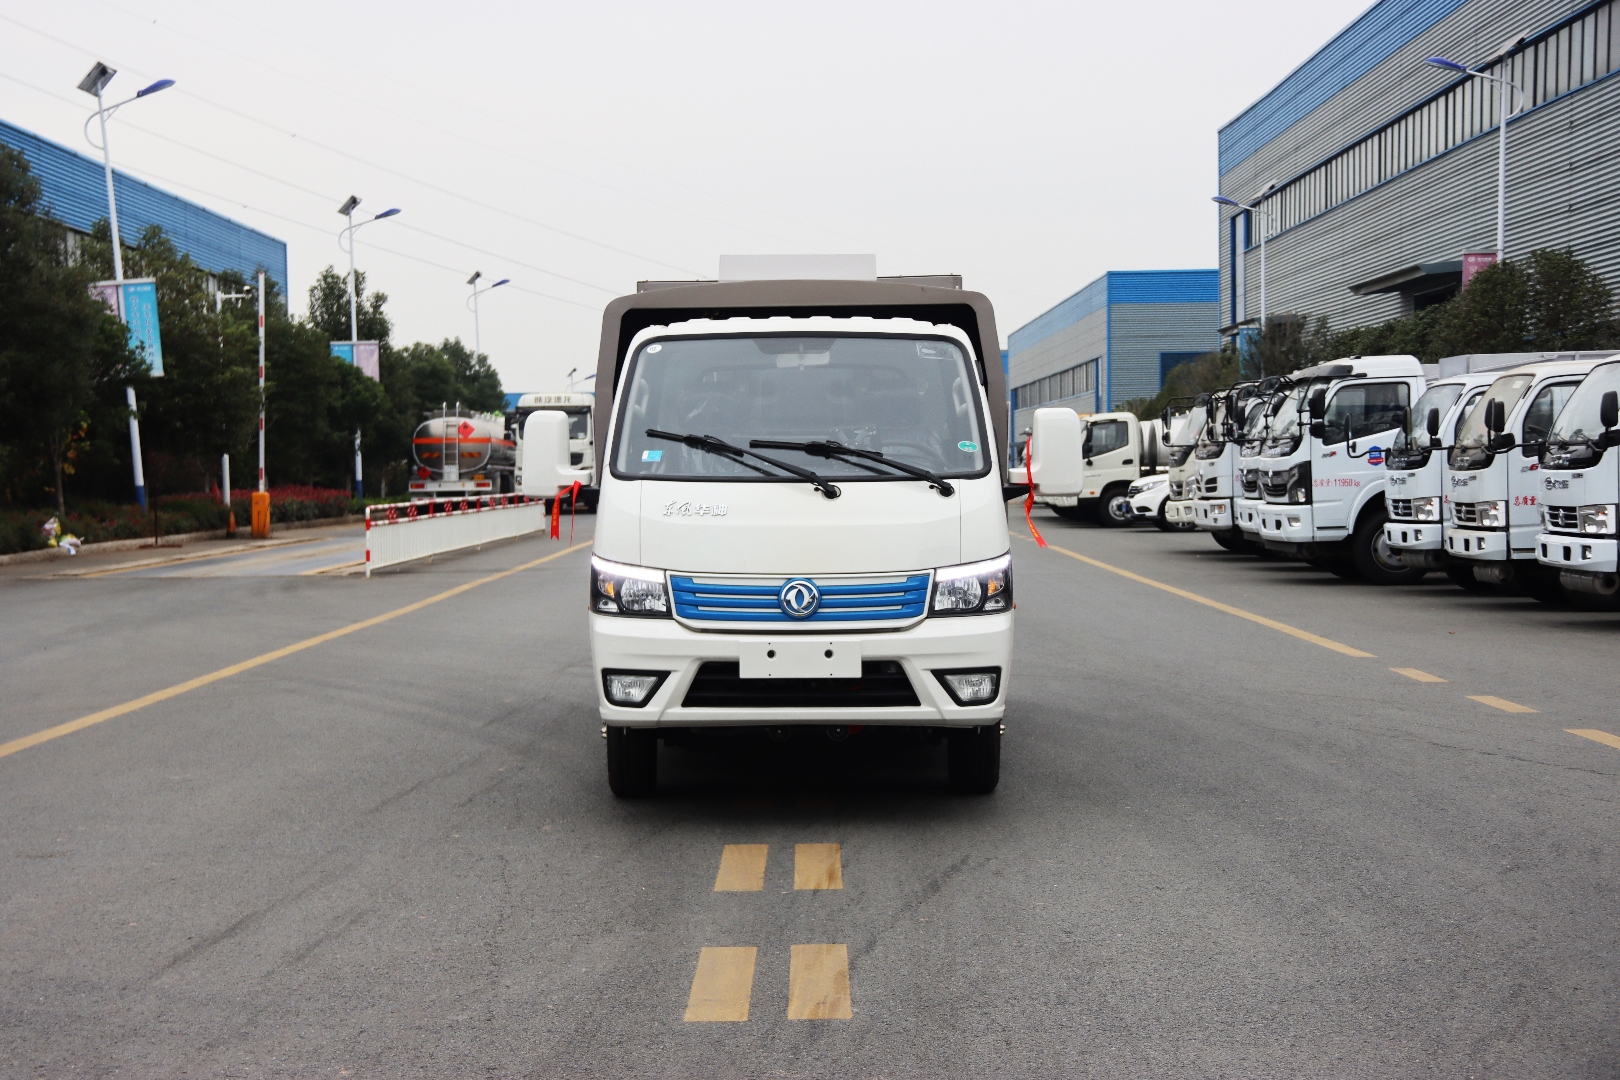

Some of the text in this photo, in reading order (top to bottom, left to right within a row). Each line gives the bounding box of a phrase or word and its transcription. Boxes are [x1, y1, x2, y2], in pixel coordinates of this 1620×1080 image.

[662, 499, 729, 517] 东风华神
[1513, 495, 1537, 507] 总质量
